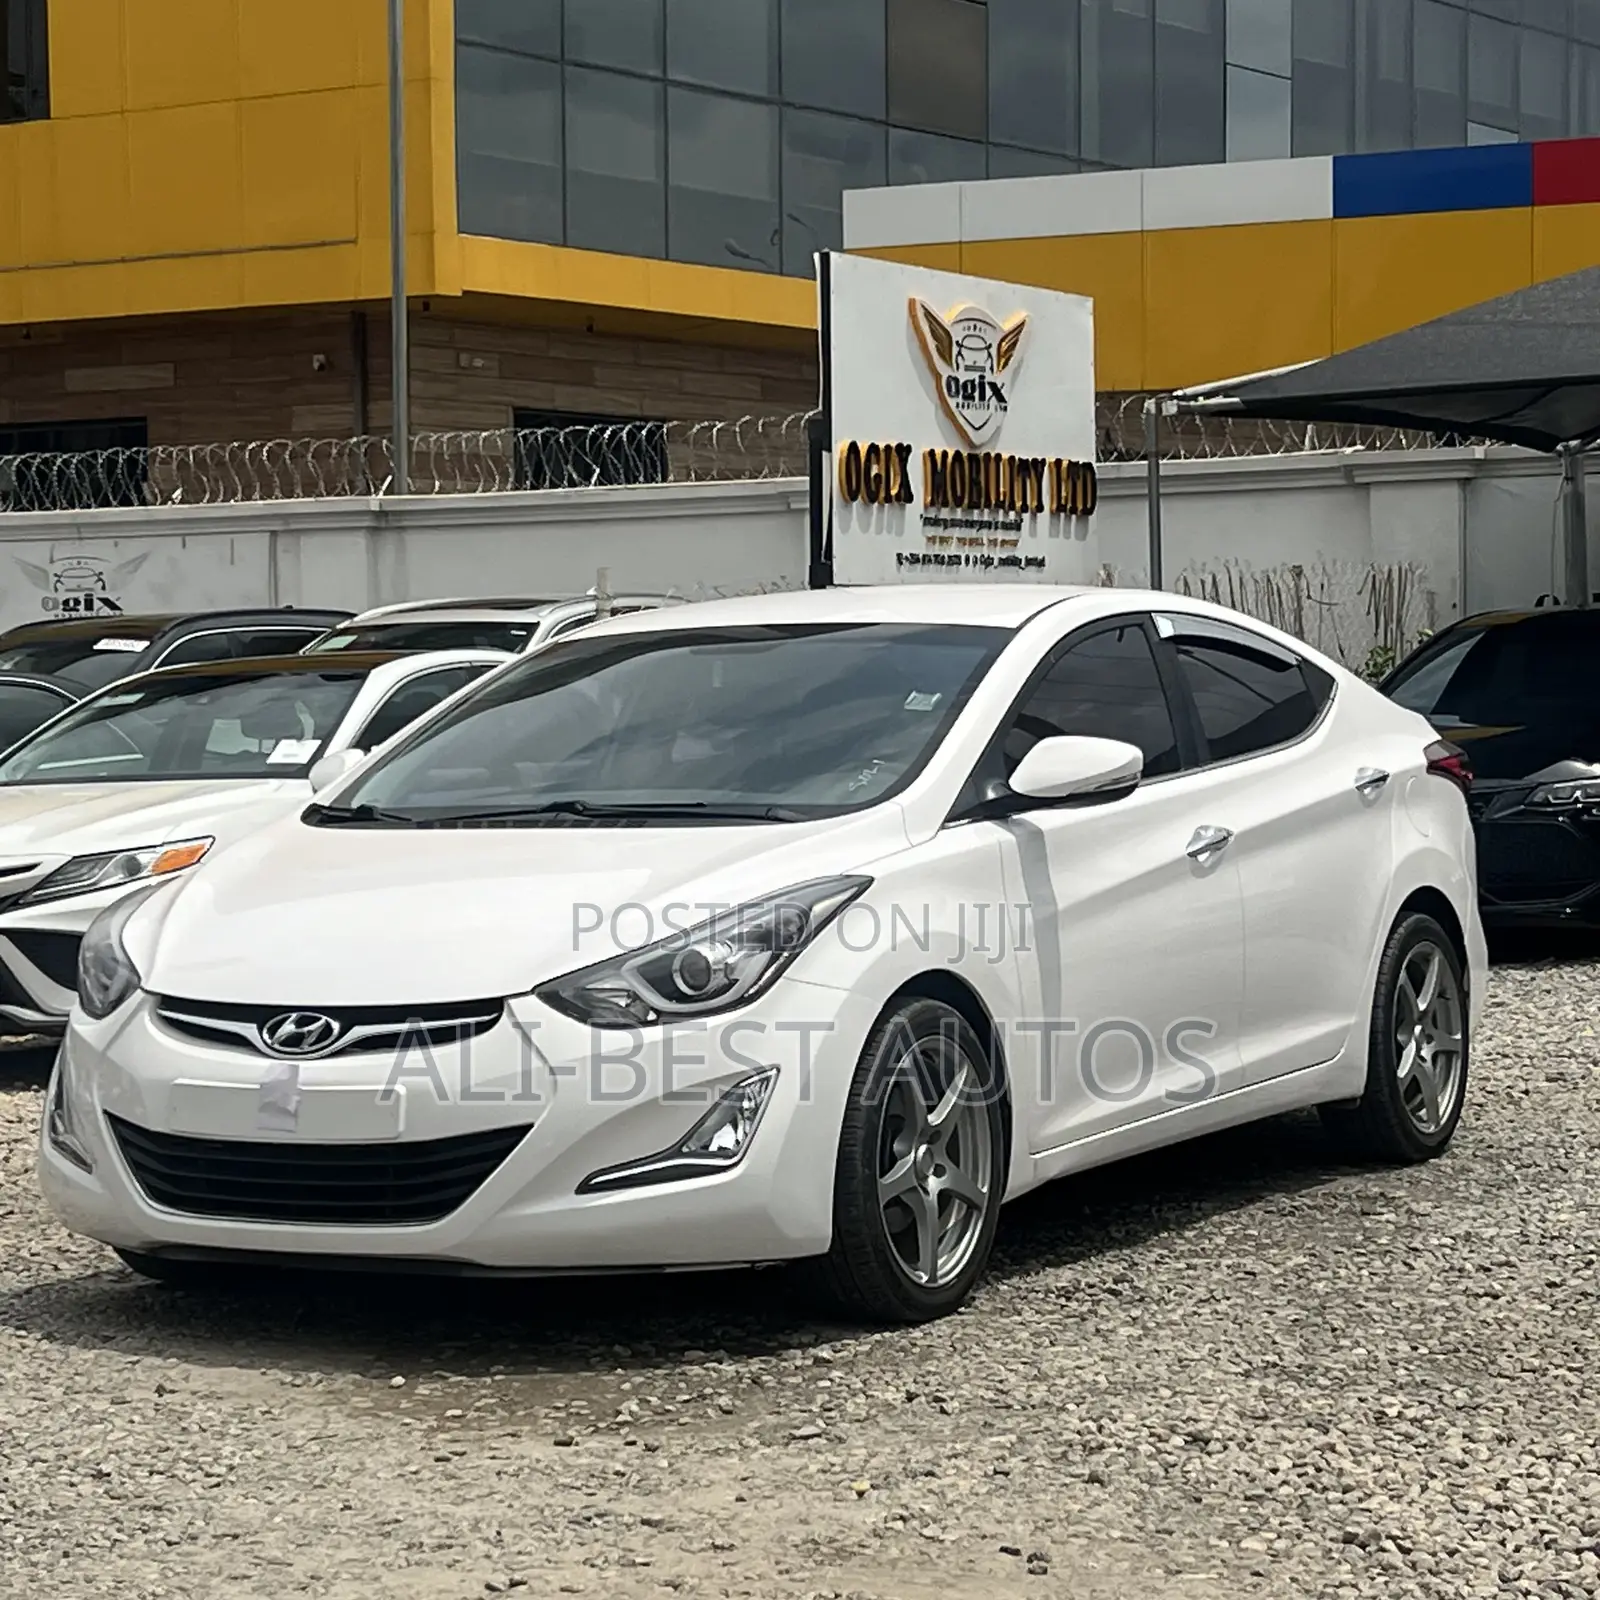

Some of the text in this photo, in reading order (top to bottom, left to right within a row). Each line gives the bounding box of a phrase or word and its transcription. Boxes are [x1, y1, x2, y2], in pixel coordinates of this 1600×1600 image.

[838, 440, 1098, 517] OGIX MOBILITY LTD
